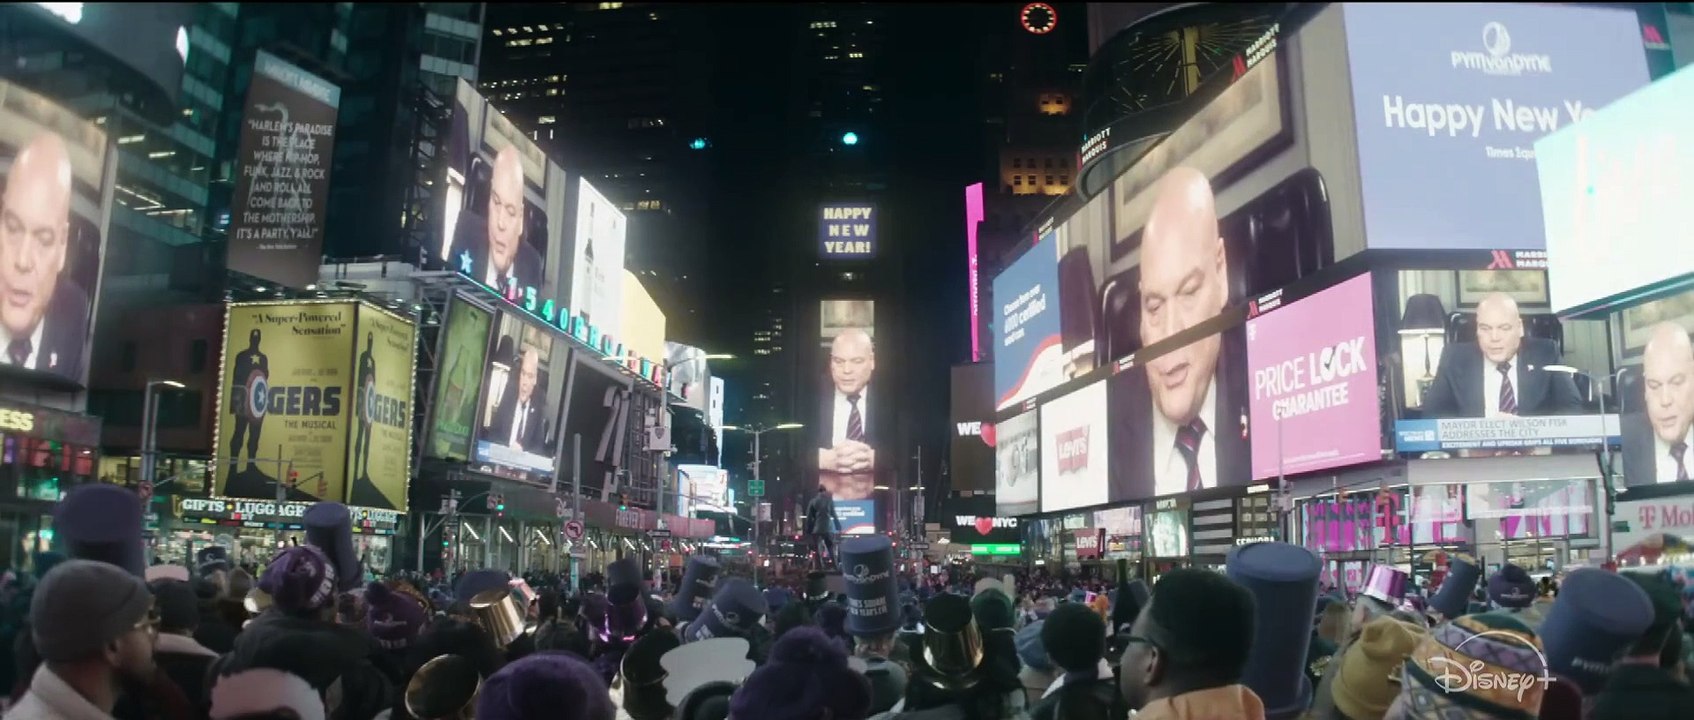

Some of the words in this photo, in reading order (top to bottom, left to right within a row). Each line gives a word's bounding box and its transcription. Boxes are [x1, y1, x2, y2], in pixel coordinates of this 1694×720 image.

[1383, 95, 1484, 136] Happy
[1492, 98, 1558, 131] New
[294, 122, 333, 136] PARADISE
[243, 212, 260, 222] THE
[824, 208, 872, 220] HAPPY
[829, 224, 870, 237] NEW
[824, 241, 871, 253] YEAR!
[292, 323, 347, 336] Sensation"
[1255, 356, 1305, 400] PRICE
[1309, 336, 1367, 386] LOCK
[284, 420, 298, 429] THE
[301, 421, 336, 430] MUSICAL
[957, 422, 981, 436] WE
[1441, 430, 1497, 439] ADDRESSES
[182, 499, 225, 512] GIFTS
[956, 515, 976, 526] WE
[992, 517, 1017, 528] NYC
